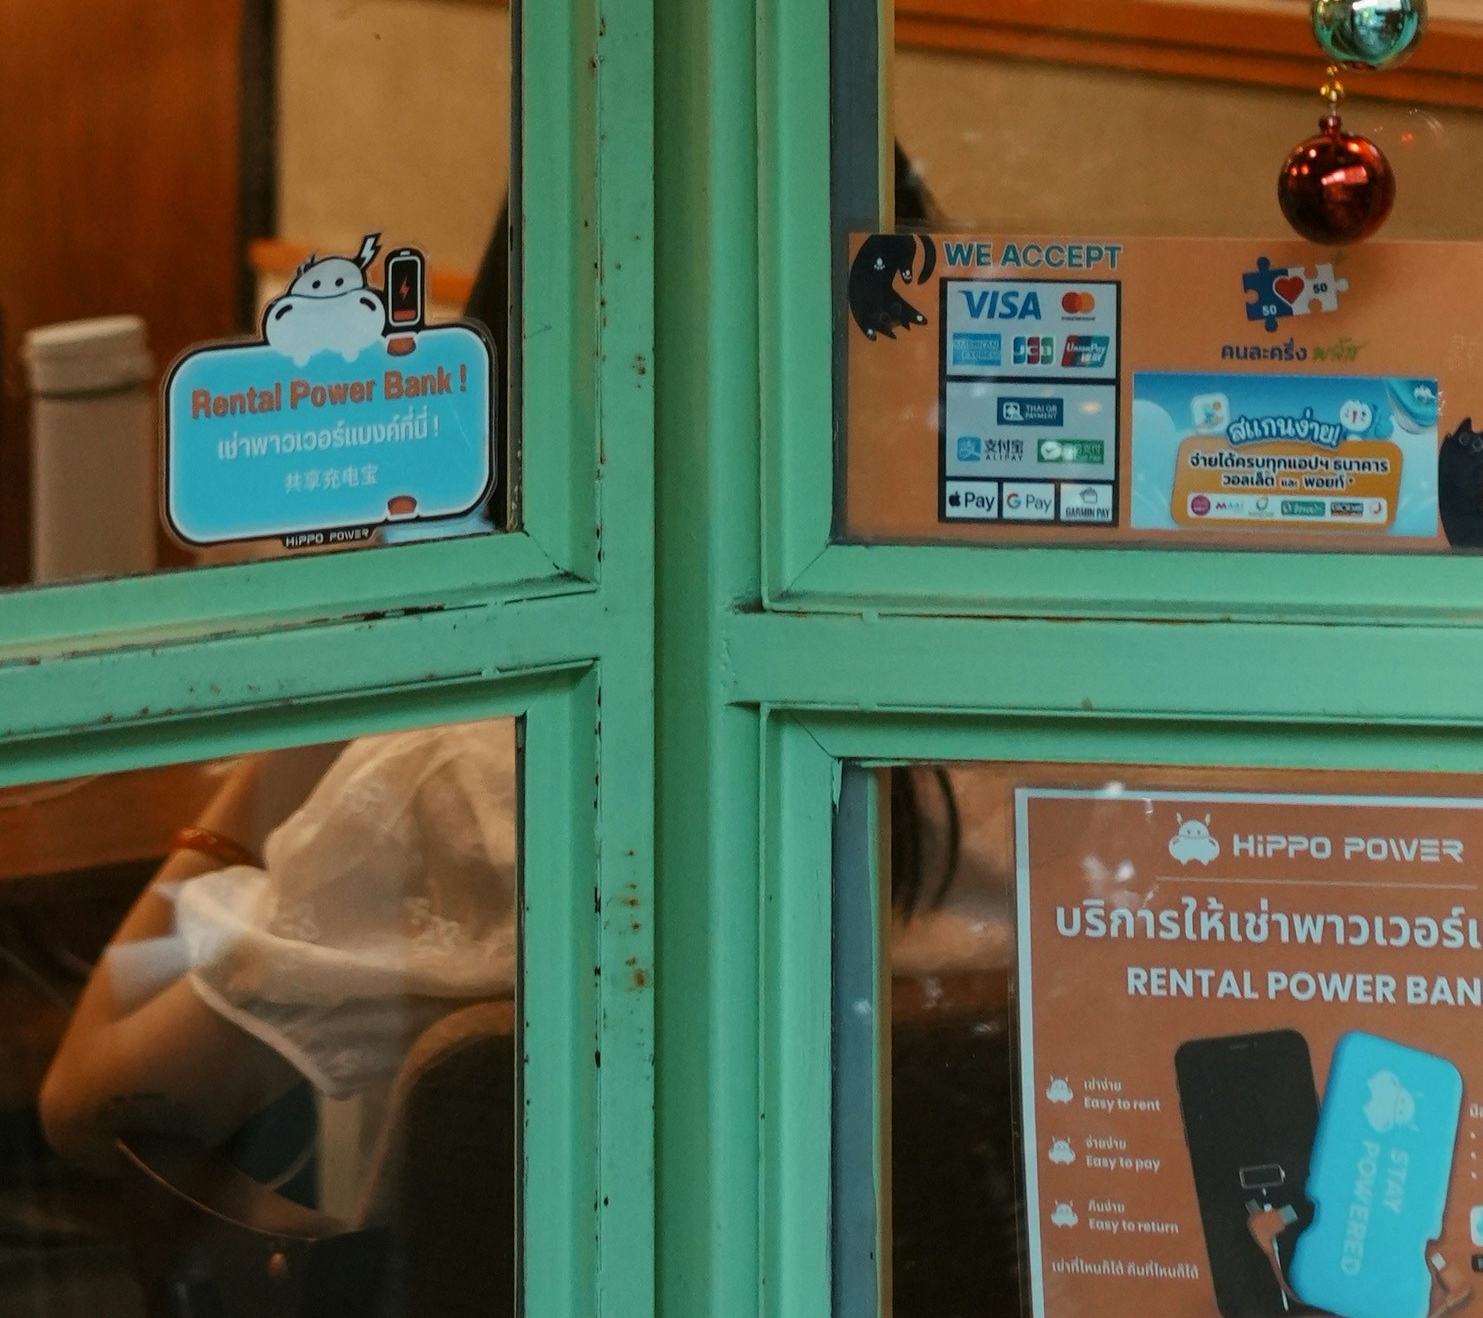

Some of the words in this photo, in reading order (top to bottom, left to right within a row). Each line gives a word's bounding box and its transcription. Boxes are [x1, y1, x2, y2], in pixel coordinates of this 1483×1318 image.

[943, 241, 992, 268] WE
[1000, 243, 1122, 270] ACCEPT
[1312, 282, 1328, 294] 50
[958, 289, 1042, 320] VISA
[1262, 304, 1278, 317] 50
[191, 381, 282, 420] Rental
[290, 377, 377, 410] Power
[384, 366, 453, 399] Bank
[1333, 458, 1389, 473] ธนาคาร
[284, 463, 380, 495] 共享充电宝
[964, 491, 995, 512] Pay
[1026, 494, 1052, 512] Pay
[329, 527, 371, 543] POWER
[1344, 836, 1466, 863] POWER
[1127, 966, 1260, 1000] RENTAL
[1267, 969, 1397, 1005] POWER
[1084, 1096, 1114, 1113] Easy
[1117, 1098, 1131, 1111] to
[1133, 1099, 1161, 1112] rent
[1086, 1155, 1116, 1171] Easy
[1119, 1156, 1133, 1169] to
[1134, 1158, 1160, 1174] pay
[1341, 1139, 1381, 1276] POWERED
[1089, 1218, 1119, 1234] Easy
[1121, 1219, 1136, 1232] to
[1137, 1220, 1179, 1234] return
